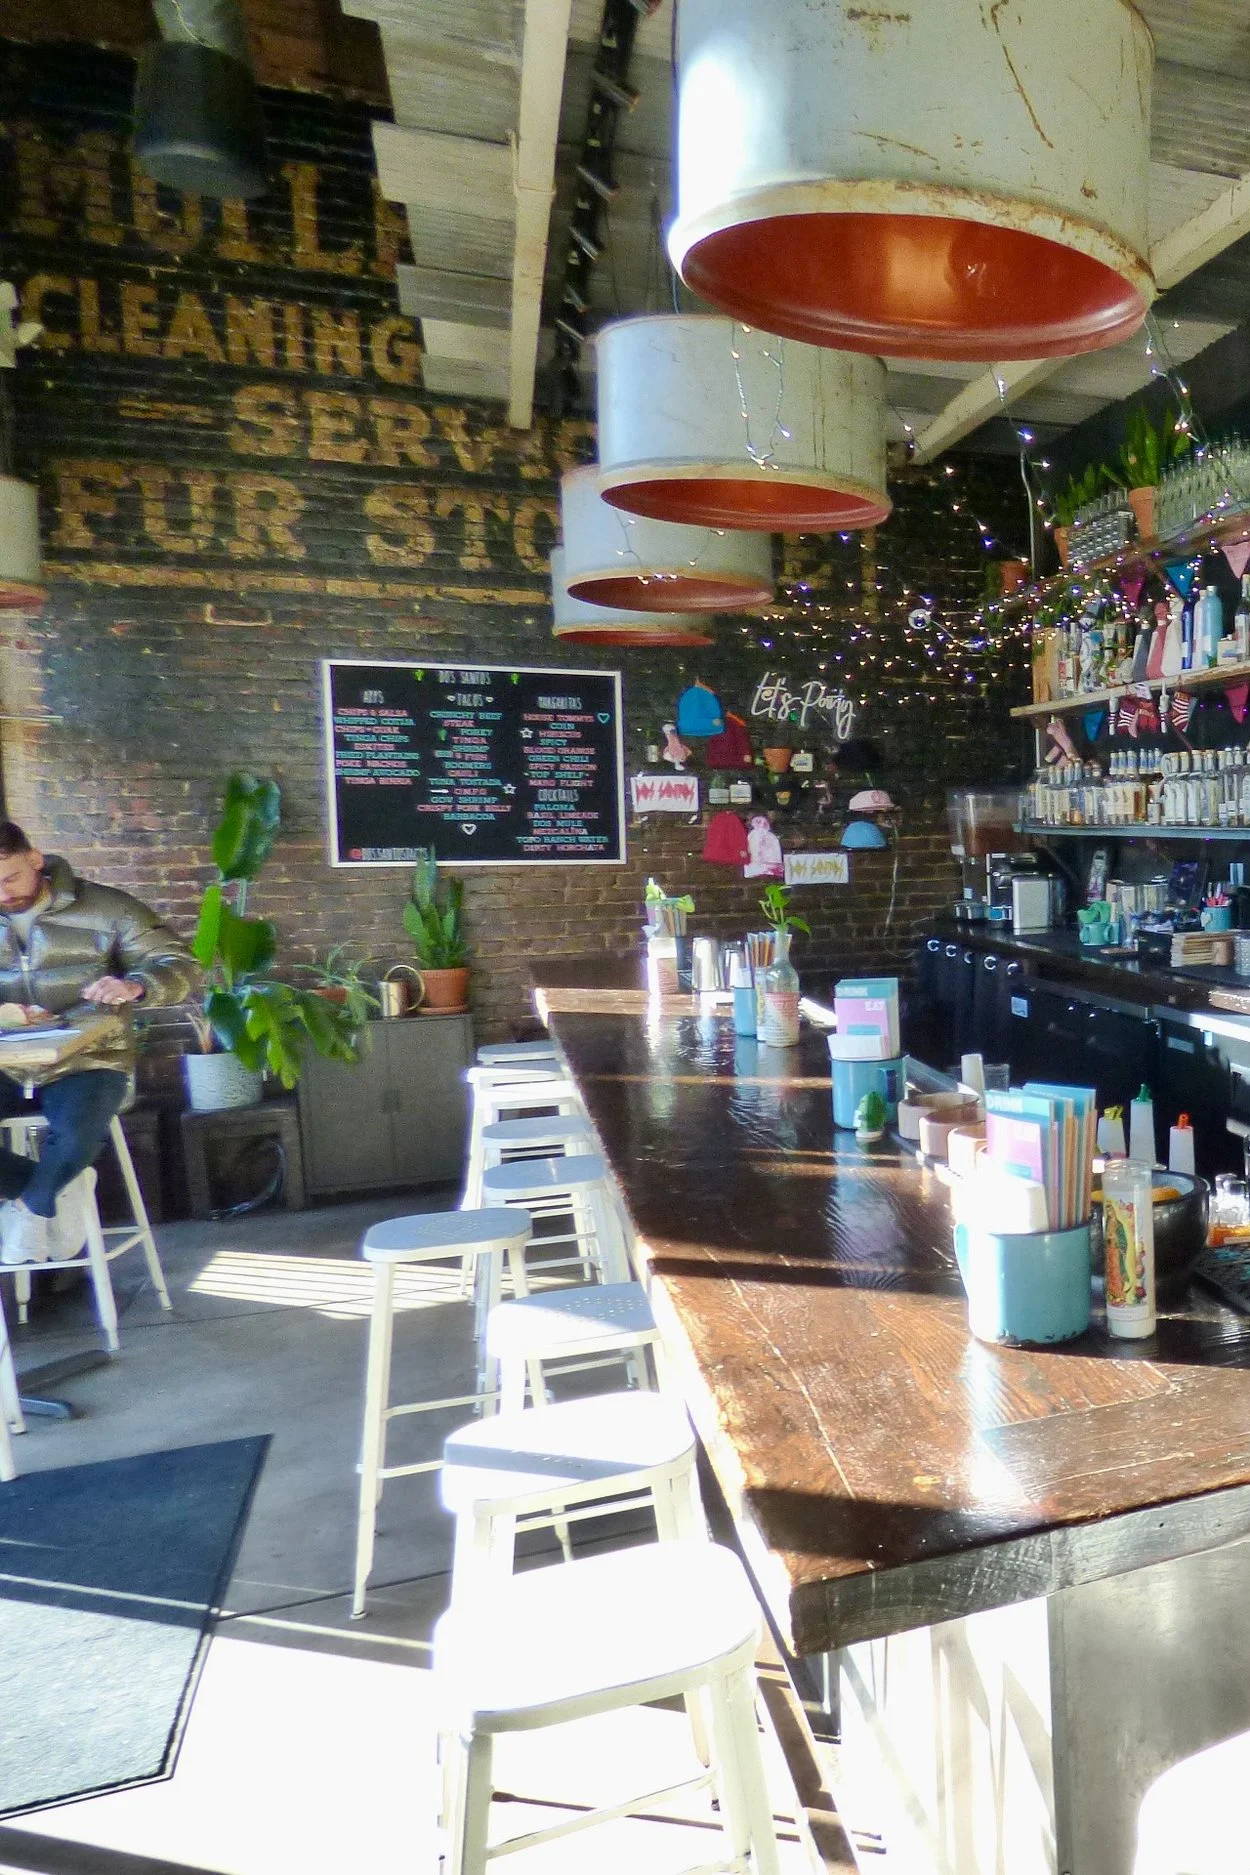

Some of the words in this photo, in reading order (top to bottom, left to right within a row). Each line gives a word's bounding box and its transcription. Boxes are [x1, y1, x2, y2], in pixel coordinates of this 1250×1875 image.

[21, 274, 425, 386] CLEANING
[51, 457, 307, 560] FUR
[751, 671, 800, 721] Let's
[800, 680, 857, 739] Party
[478, 712, 502, 720] BEEF
[550, 722, 576, 731] COIN
[460, 728, 494, 737] PORKY
[380, 735, 410, 743] CHIPS
[452, 736, 488, 744] TINGA
[539, 738, 568, 747] SPICY
[527, 754, 561, 763] GREEN
[562, 755, 590, 763] CHILI
[459, 778, 502, 786] TOSTADA
[534, 803, 577, 811] PALOMA
[443, 812, 496, 821] BARBACOA
[556, 819, 584, 828] MULE
